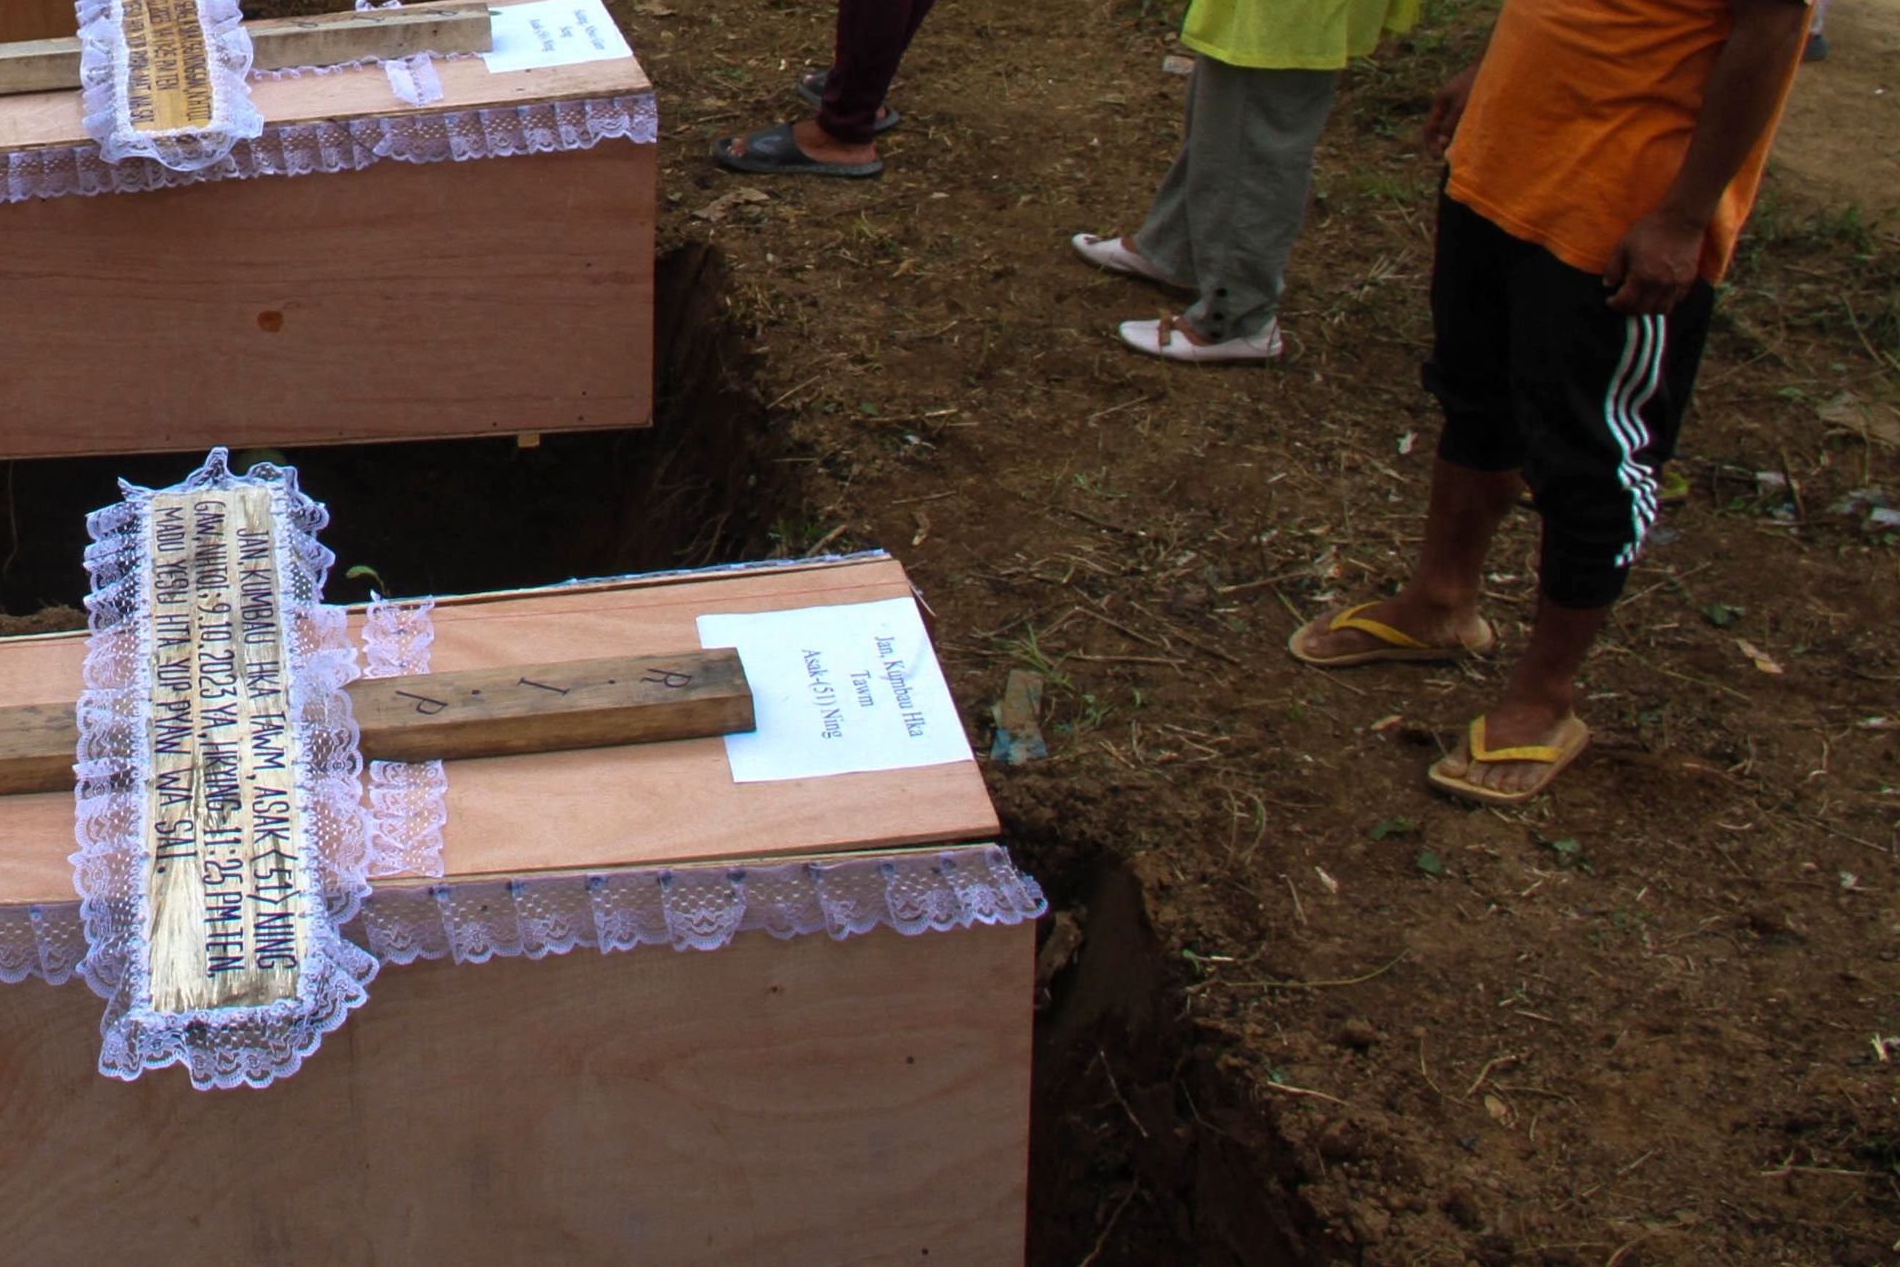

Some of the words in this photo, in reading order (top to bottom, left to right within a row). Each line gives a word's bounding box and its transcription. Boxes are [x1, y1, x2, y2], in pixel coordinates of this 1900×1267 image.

[155, 506, 187, 552] MADU
[155, 559, 189, 605] YESU
[239, 570, 276, 645] KUMBAU
[156, 614, 190, 649] HTA
[196, 602, 237, 700] 9.10.2023
[874, 636, 895, 658] Jan,
[157, 657, 192, 692] YUP
[246, 661, 281, 699] HKA
[849, 670, 875, 708] Tawm
[883, 660, 914, 709] Kumbau
[154, 699, 193, 756] PYAW
[820, 707, 845, 740] Ning
[901, 711, 927, 738] Hka
[157, 767, 193, 807] WA
[199, 741, 243, 812] HKYING
[252, 786, 291, 844] ASAK
[155, 819, 198, 876] SAI.
[203, 826, 244, 885] 11:25
[204, 891, 244, 923] PM
[253, 912, 298, 970] NING
